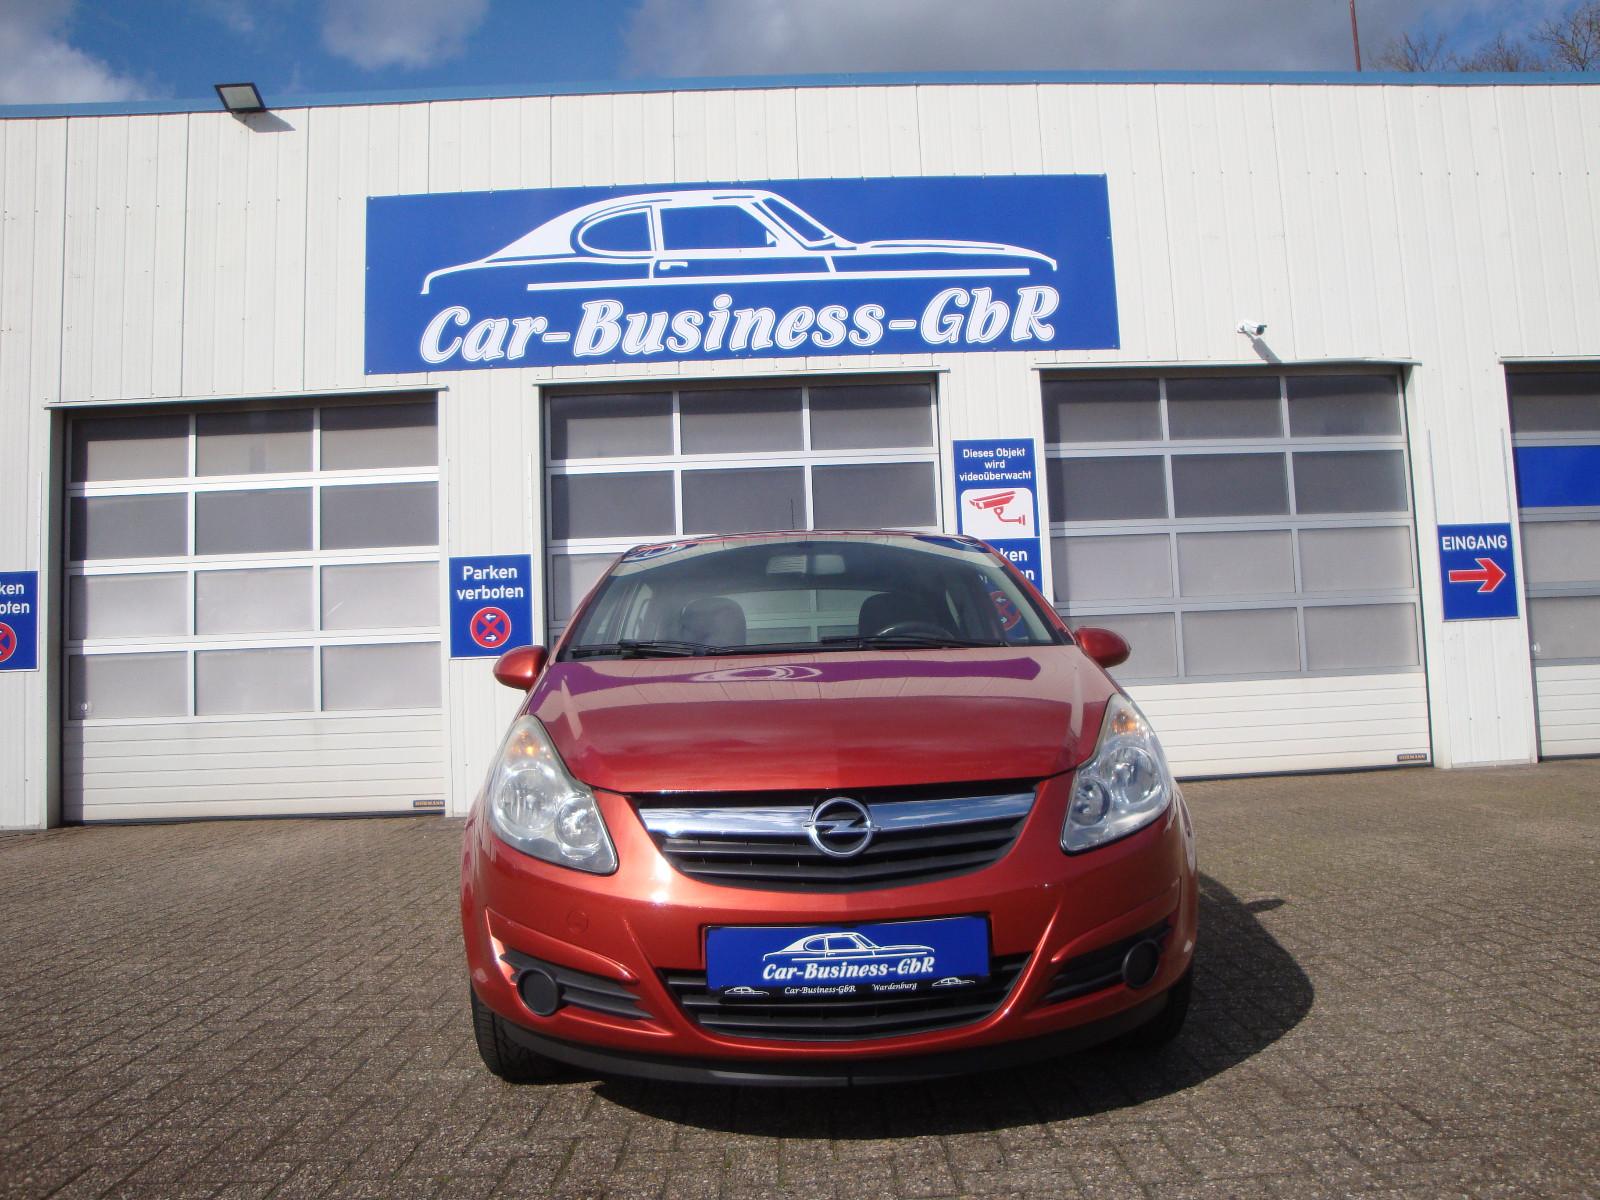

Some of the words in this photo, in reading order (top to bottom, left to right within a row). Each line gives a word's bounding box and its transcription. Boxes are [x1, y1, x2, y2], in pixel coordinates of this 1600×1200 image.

[420, 285, 1060, 364] Car-Business-GbR
[963, 449, 994, 458] Dieses
[996, 447, 1026, 458] Objekt
[984, 460, 1006, 469] wird
[959, 470, 1032, 482] videoüberwacht
[1441, 534, 1508, 550] EINGANG
[999, 548, 1028, 562] ken
[463, 564, 518, 581] Parken
[456, 585, 524, 601] verboten
[762, 957, 935, 980] Car-Business-GbR
[784, 985, 856, 995] Car-Business-GbR
[872, 982, 918, 991] Wardenburg
